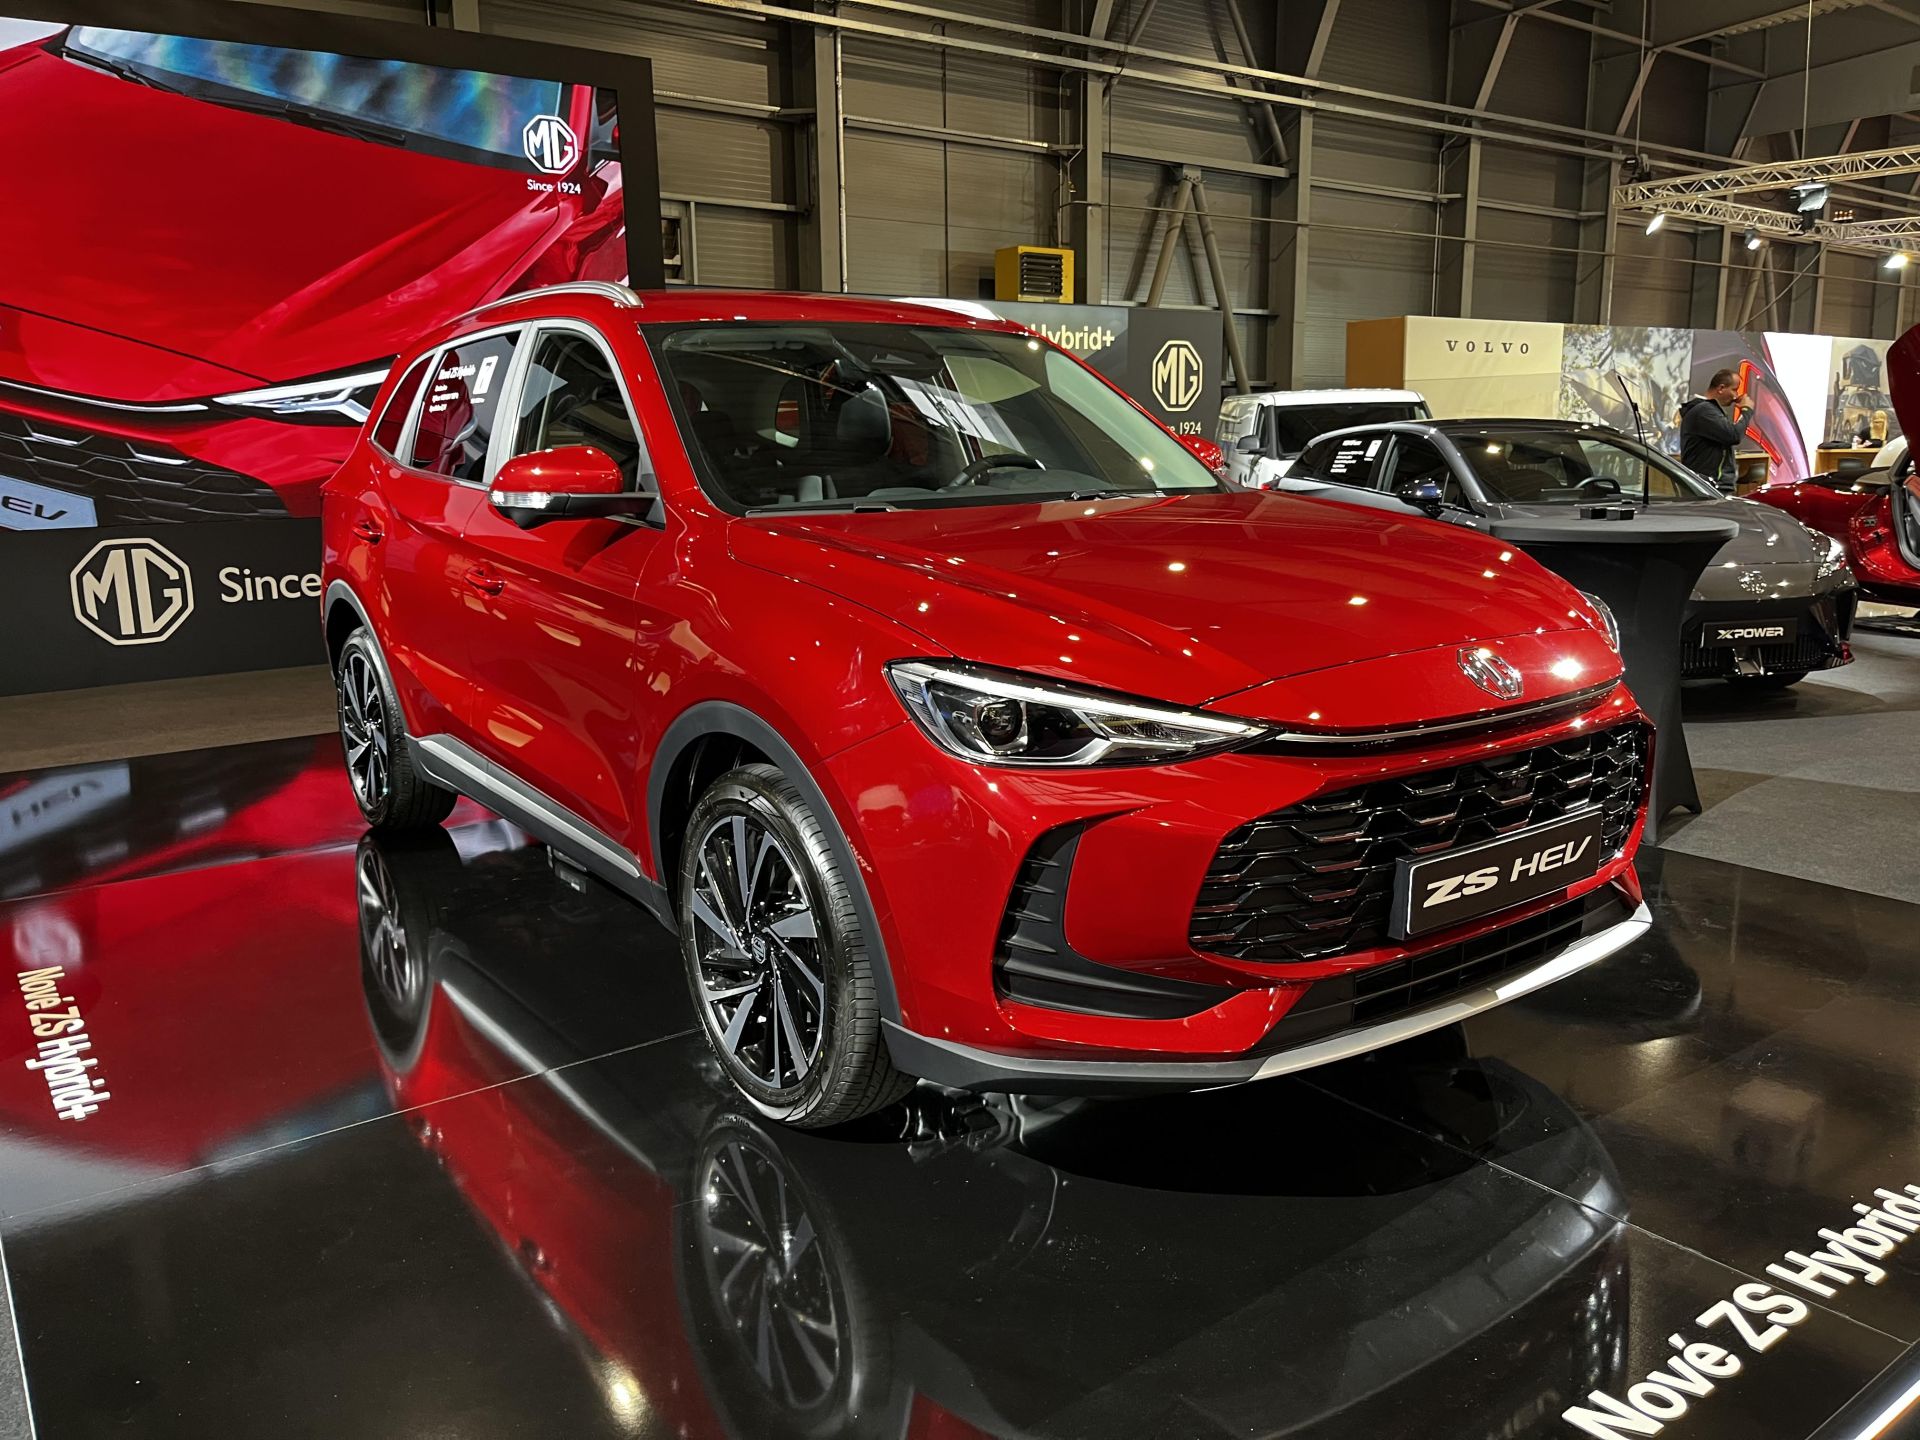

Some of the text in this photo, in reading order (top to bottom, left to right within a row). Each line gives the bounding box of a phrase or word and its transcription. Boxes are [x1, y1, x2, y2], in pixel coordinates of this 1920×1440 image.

[527, 119, 574, 170] MG
[526, 178, 582, 195] Since 1924
[1445, 340, 1529, 354] VOLVO
[1156, 346, 1199, 406] MG
[1179, 421, 1202, 435] 1924
[1, 495, 68, 521] EV
[81, 547, 184, 636] MG
[218, 566, 322, 604] Since
[1716, 626, 1784, 640] XPOWER
[1422, 835, 1592, 908] ZS HEV
[17, 965, 111, 1121] Nové ZS Hybrid+
[1562, 1332, 1744, 1440] Nové
[1695, 1283, 1810, 1353] ZS
